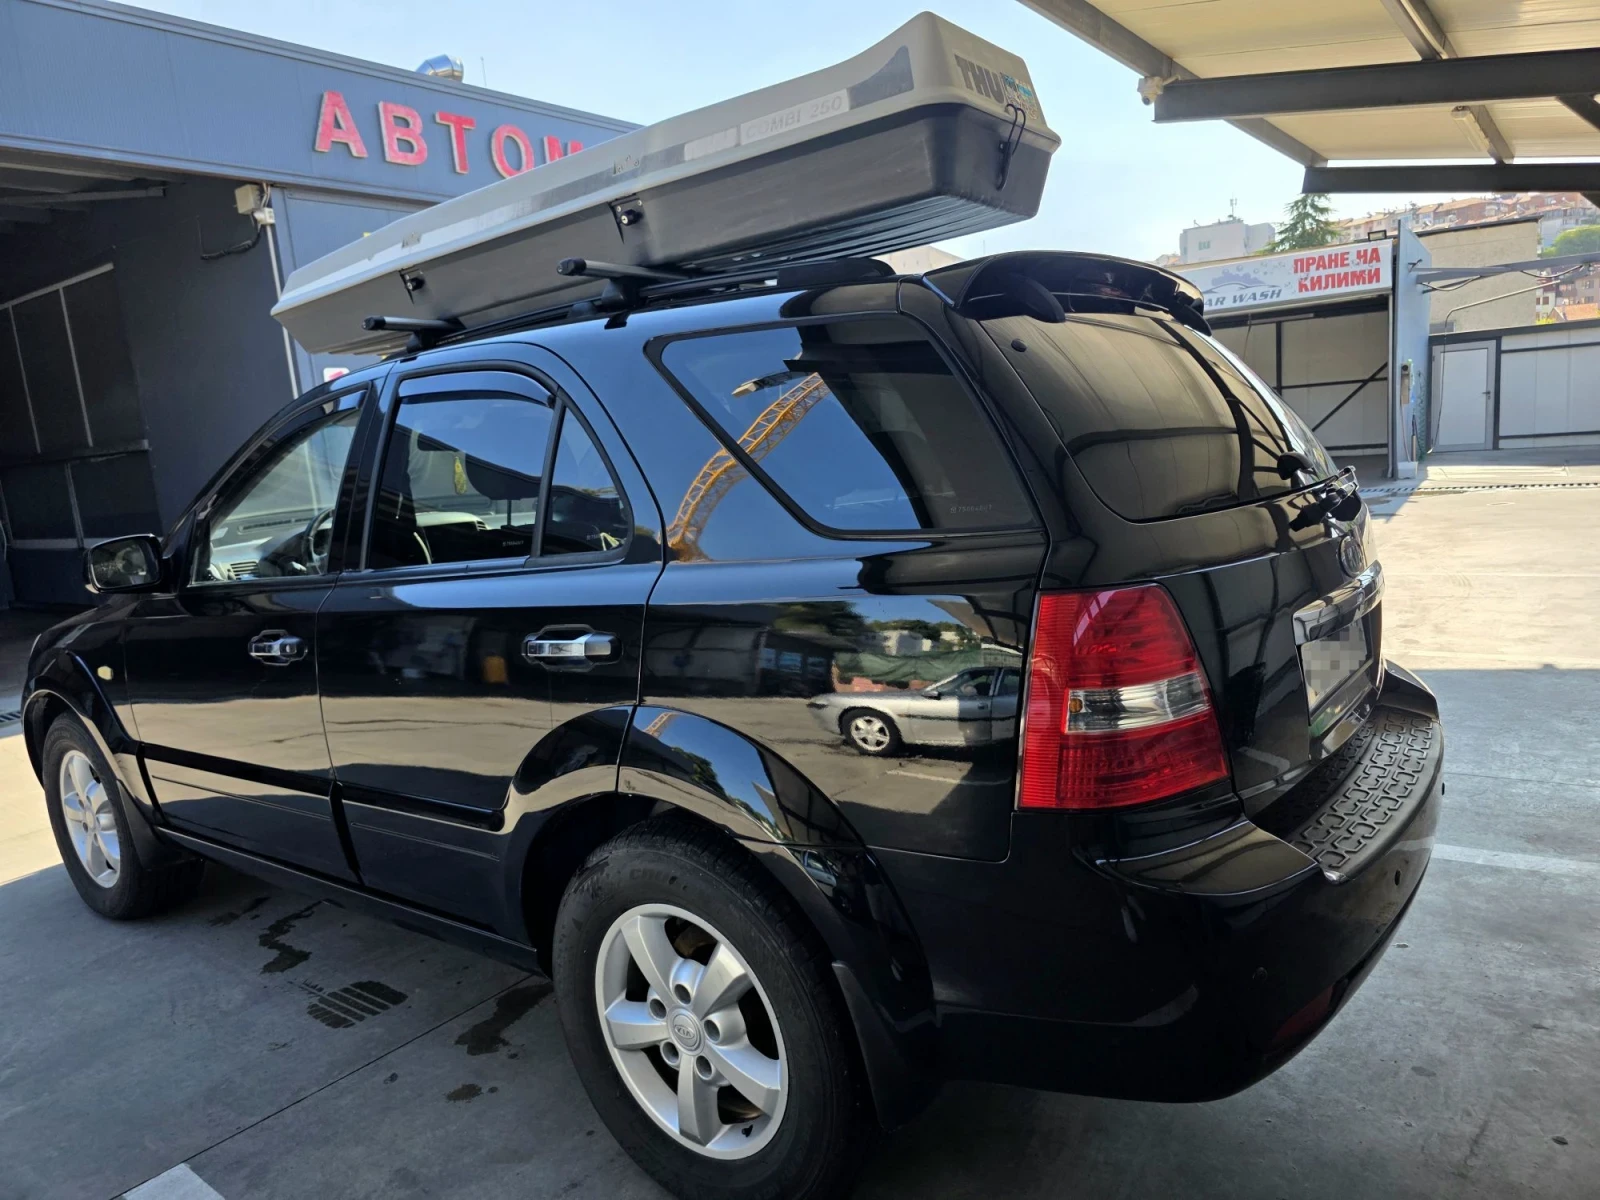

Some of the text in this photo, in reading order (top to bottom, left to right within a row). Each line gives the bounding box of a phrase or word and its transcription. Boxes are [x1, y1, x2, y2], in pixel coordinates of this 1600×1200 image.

[954, 54, 1005, 104] THU
[745, 95, 843, 138] COMBI 250
[1293, 247, 1381, 274] ПРАНЕ НА
[1298, 267, 1381, 293] КИЛИМИ
[1204, 288, 1283, 307] AR WASH
[676, 1027, 692, 1038] KIA
